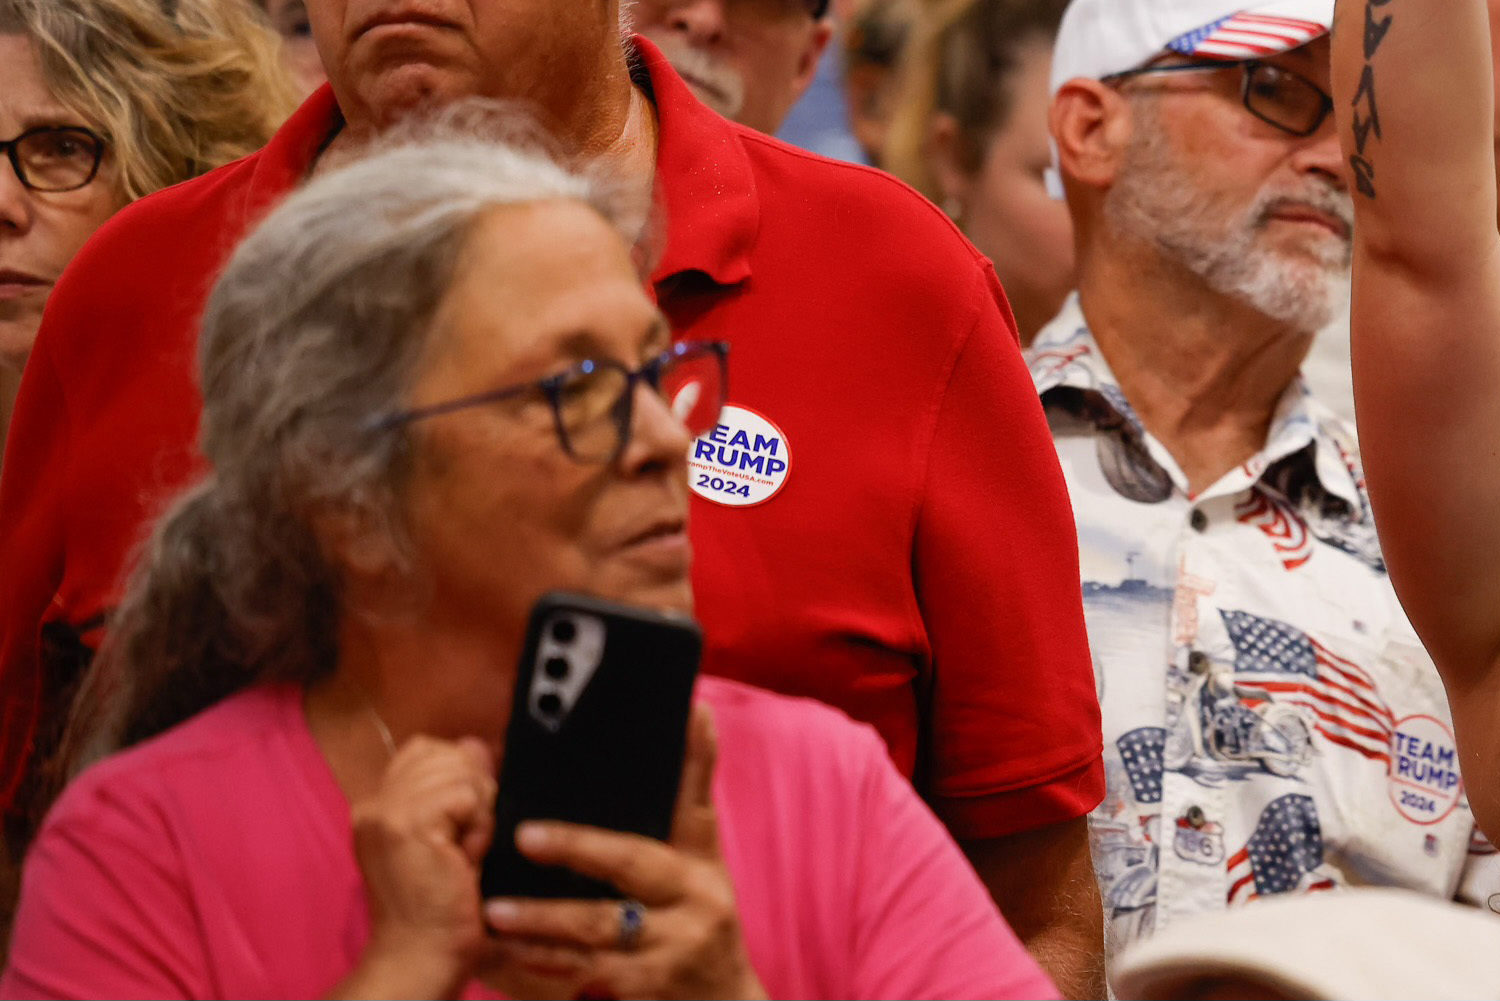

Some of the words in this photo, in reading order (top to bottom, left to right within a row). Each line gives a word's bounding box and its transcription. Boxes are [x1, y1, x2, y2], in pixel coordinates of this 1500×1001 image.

[695, 438, 786, 477] RUMP
[707, 424, 779, 457] EAM
[697, 473, 750, 498] 2024
[1394, 731, 1455, 769] TEAM
[1396, 755, 1460, 791] RUMP
